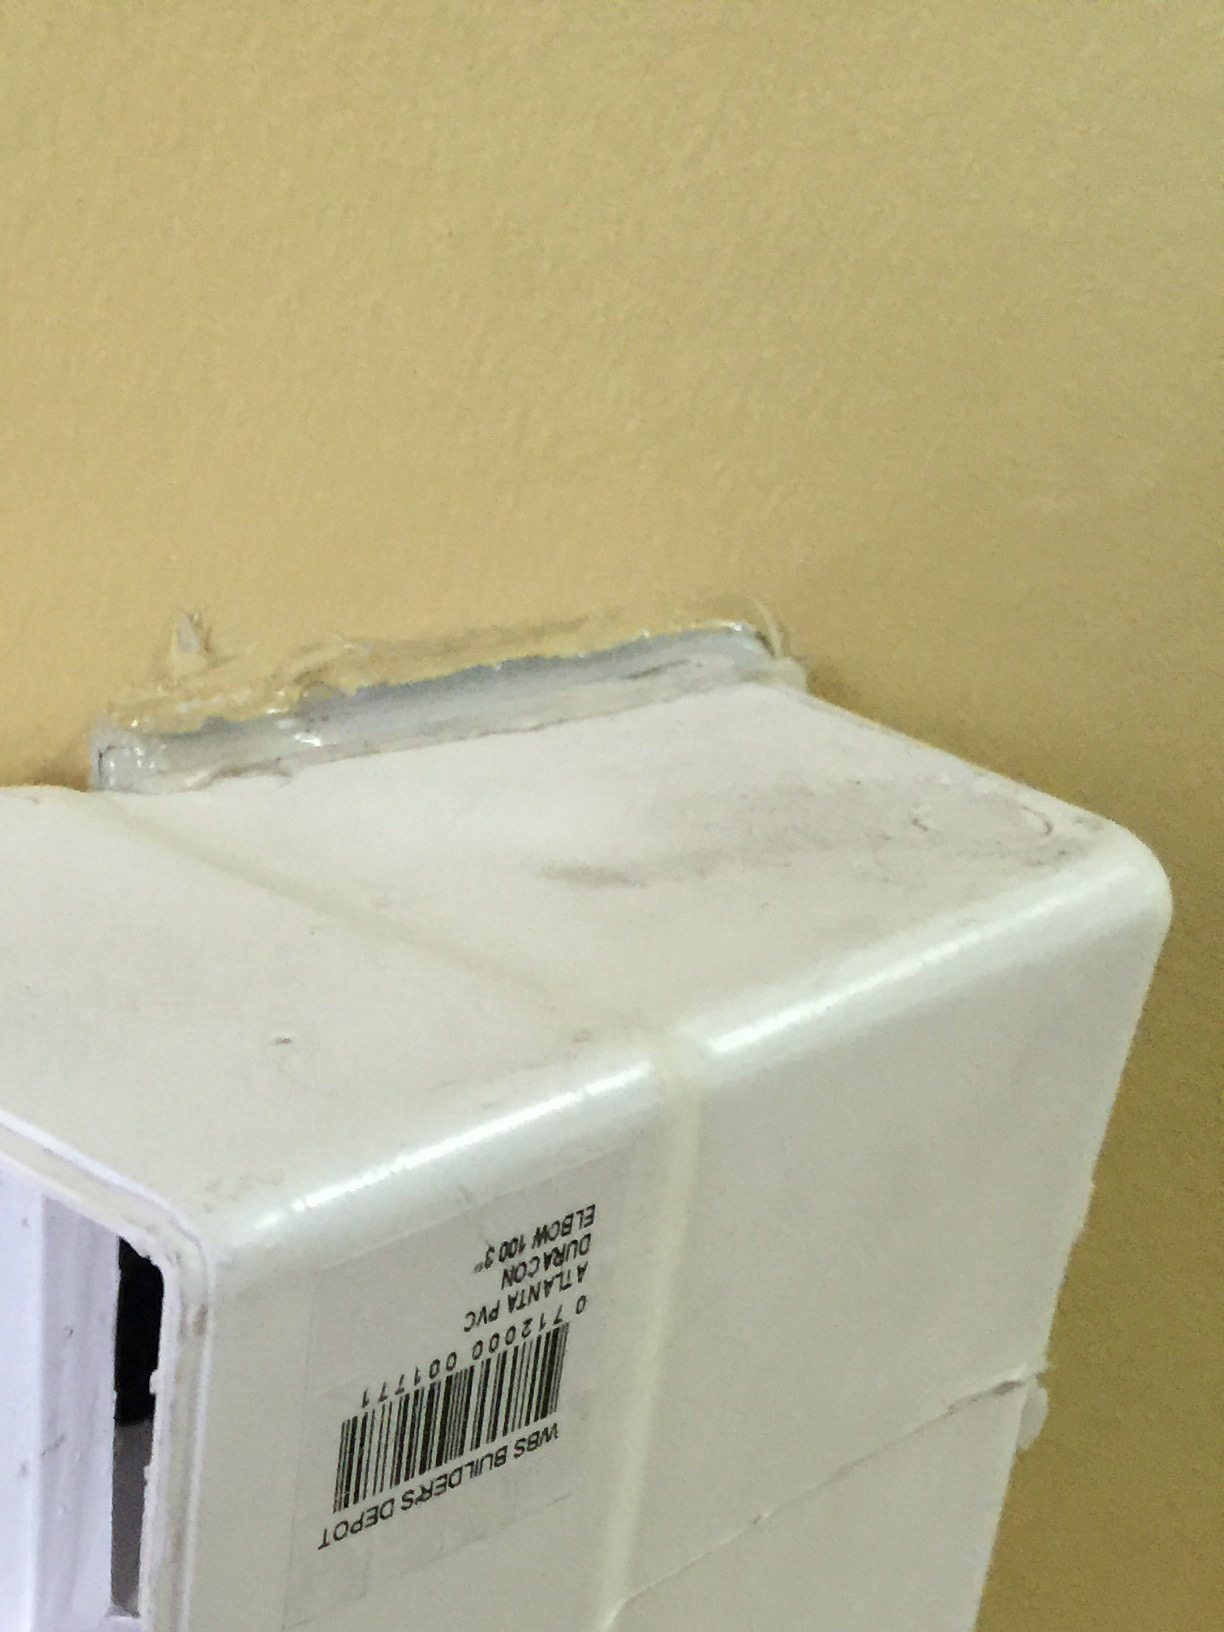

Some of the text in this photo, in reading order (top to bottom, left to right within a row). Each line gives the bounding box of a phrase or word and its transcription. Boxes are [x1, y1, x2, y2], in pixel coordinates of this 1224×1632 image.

[501, 1232, 592, 1290] DURACON
[531, 1203, 596, 1250] ELBOW
[463, 1261, 589, 1333] ATLANTA PVC
[361, 1294, 587, 1409] 0 712000 001771
[318, 1422, 559, 1551] WBS BUILDER'S DEPOT
